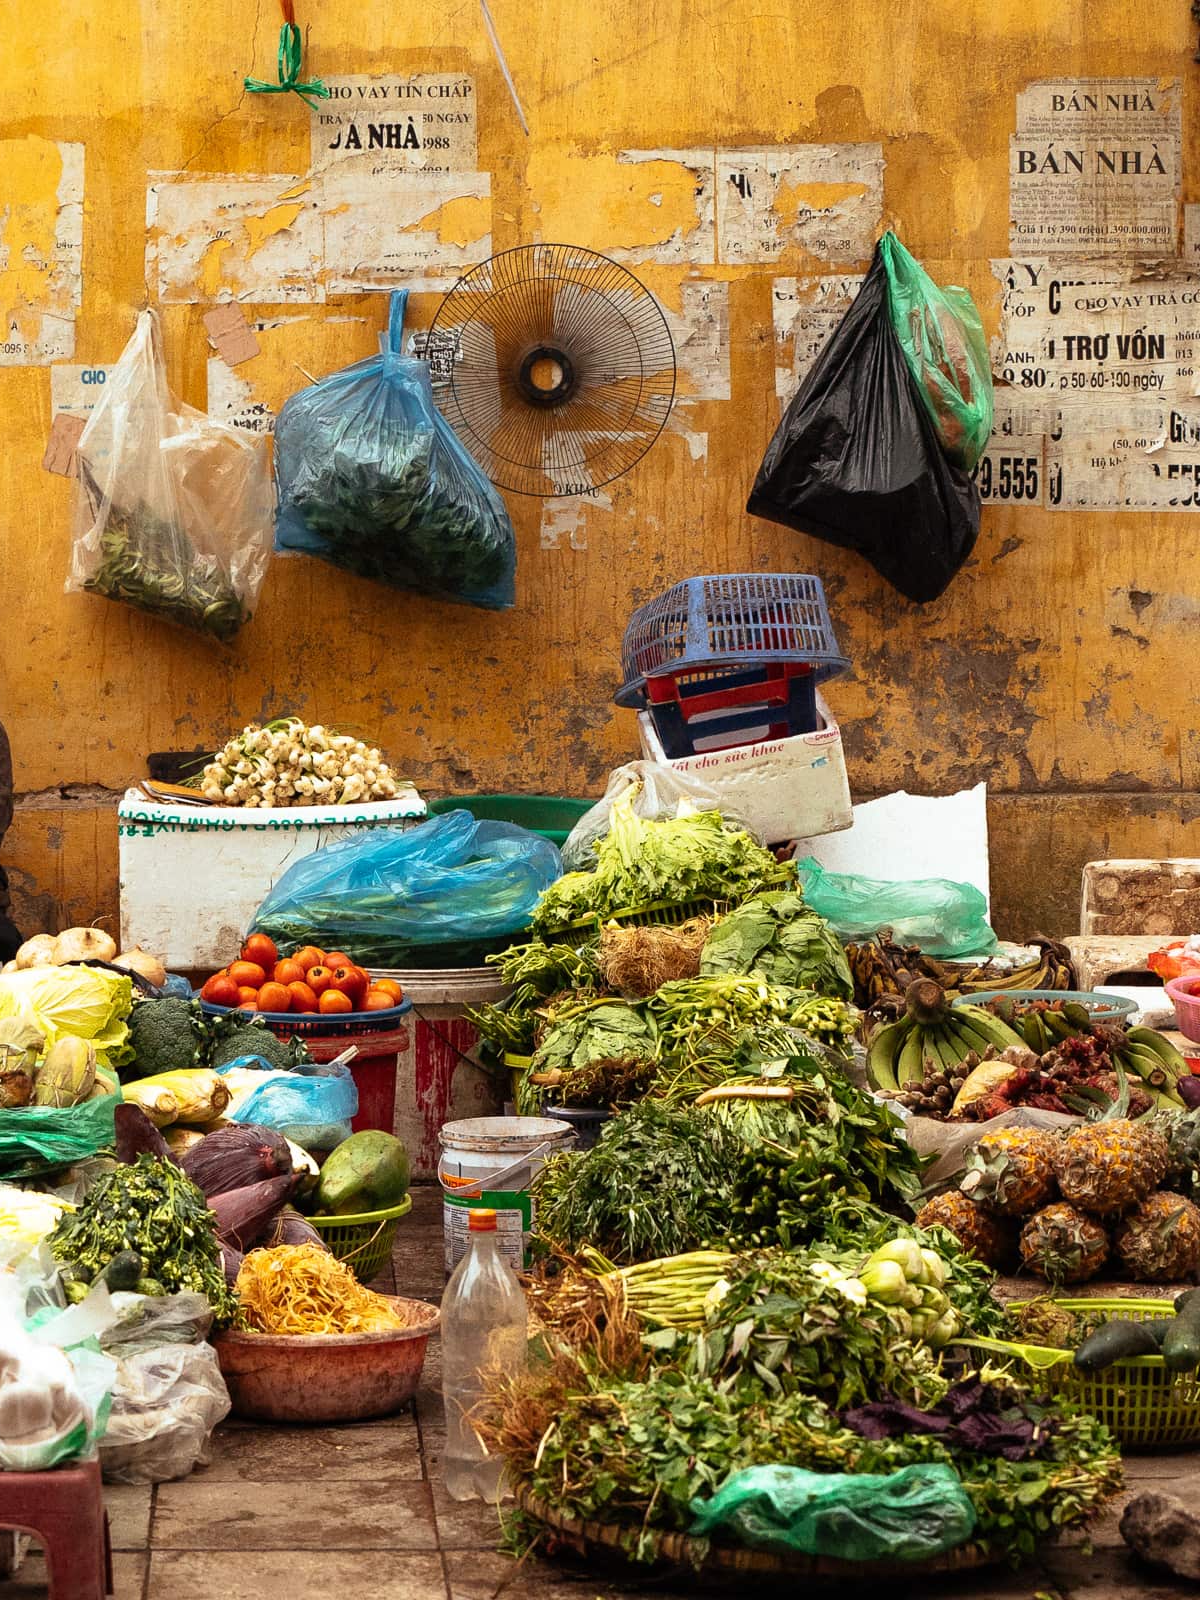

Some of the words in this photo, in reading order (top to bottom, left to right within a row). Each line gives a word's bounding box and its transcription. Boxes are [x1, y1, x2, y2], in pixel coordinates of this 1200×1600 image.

[357, 86, 391, 99] VAY
[395, 82, 423, 98] TÍN
[427, 79, 472, 99] CHẤP
[1051, 89, 1098, 113] BÁN
[1106, 89, 1155, 112] NHÀ
[367, 116, 420, 150] NHÀ
[1016, 142, 1084, 175] BÁN
[1097, 143, 1168, 175] NHÀ
[1018, 223, 1037, 234] Giá
[1060, 224, 1076, 234] 390
[1111, 296, 1143, 308] VAY
[1063, 332, 1110, 367] TRỢ
[1116, 325, 1166, 361] VỐN
[81, 369, 106, 385] CHO
[1133, 371, 1165, 392] ngày
[1135, 439, 1147, 448] 60
[694, 756, 720, 769] cho
